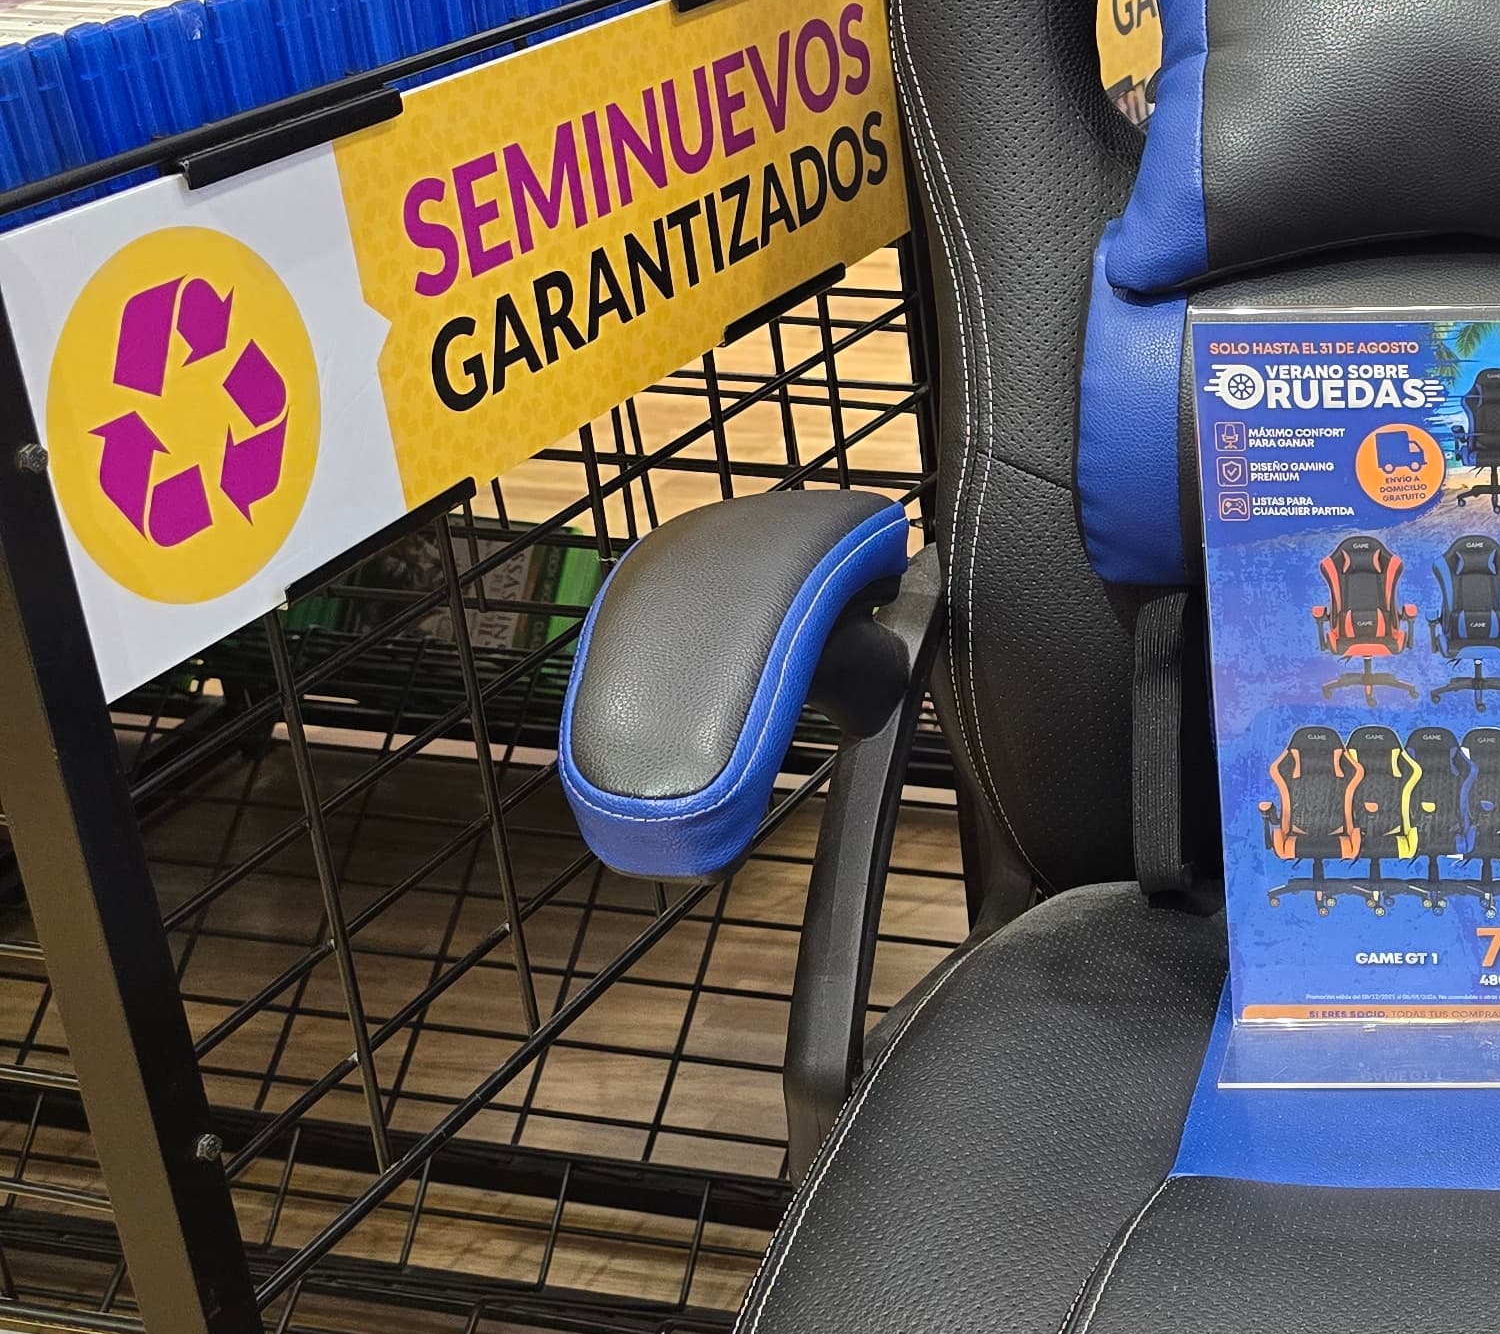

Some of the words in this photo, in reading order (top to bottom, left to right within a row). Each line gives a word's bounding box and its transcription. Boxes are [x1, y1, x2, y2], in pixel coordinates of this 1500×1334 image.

[402, 3, 874, 297] SEMINUEVOS
[432, 111, 890, 412] GARANTIZADOS
[1210, 343, 1250, 354] SOLO
[1253, 342, 1300, 354] HASTA
[1303, 343, 1318, 354] EL
[1320, 343, 1332, 354] 31
[1336, 342, 1354, 354] DE
[1357, 342, 1419, 354] AGOSTO
[1265, 365, 1343, 379] VERANO
[1348, 365, 1409, 379] SOBRE
[1266, 379, 1426, 409] RUEDAS
[1249, 426, 1293, 437] MÁXIMO
[1296, 428, 1345, 437] CONFORT
[1249, 439, 1277, 447] PARA
[1279, 439, 1315, 447] GANAR
[1250, 462, 1288, 471] DISEÑO
[1290, 462, 1334, 471] GAMING
[1251, 472, 1300, 482] PREMIUM
[1385, 475, 1411, 484] ENVÍO
[1413, 475, 1421, 483] A
[1380, 484, 1428, 493] DOMICILIO
[1252, 497, 1285, 506] LISTAS
[1287, 497, 1313, 506] PARA
[1382, 493, 1427, 502] GRATUITO
[1253, 506, 1310, 516] CUALQUIER
[1312, 507, 1354, 516] PARTIDA
[1356, 953, 1403, 964] GAME
[1405, 953, 1427, 964] GT
[1431, 953, 1438, 964] 1
